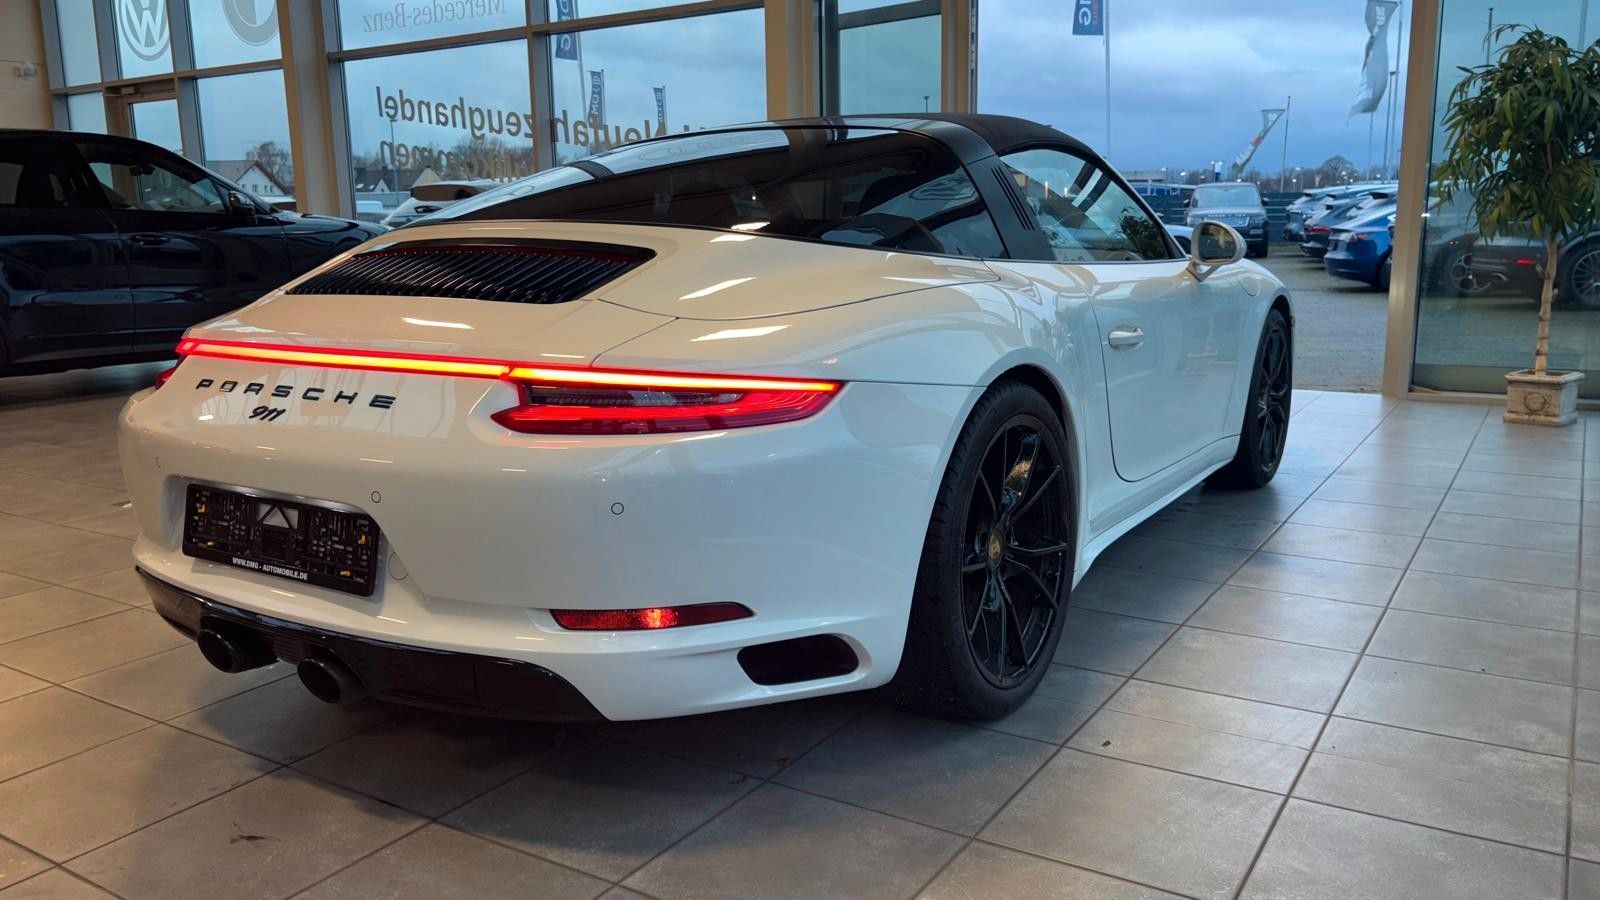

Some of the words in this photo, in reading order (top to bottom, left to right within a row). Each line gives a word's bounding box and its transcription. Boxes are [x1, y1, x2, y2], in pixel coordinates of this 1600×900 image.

[196, 378, 397, 410] PORSCHE
[249, 405, 287, 422] 911
[262, 564, 309, 580] AUTOMOBILE.DE
